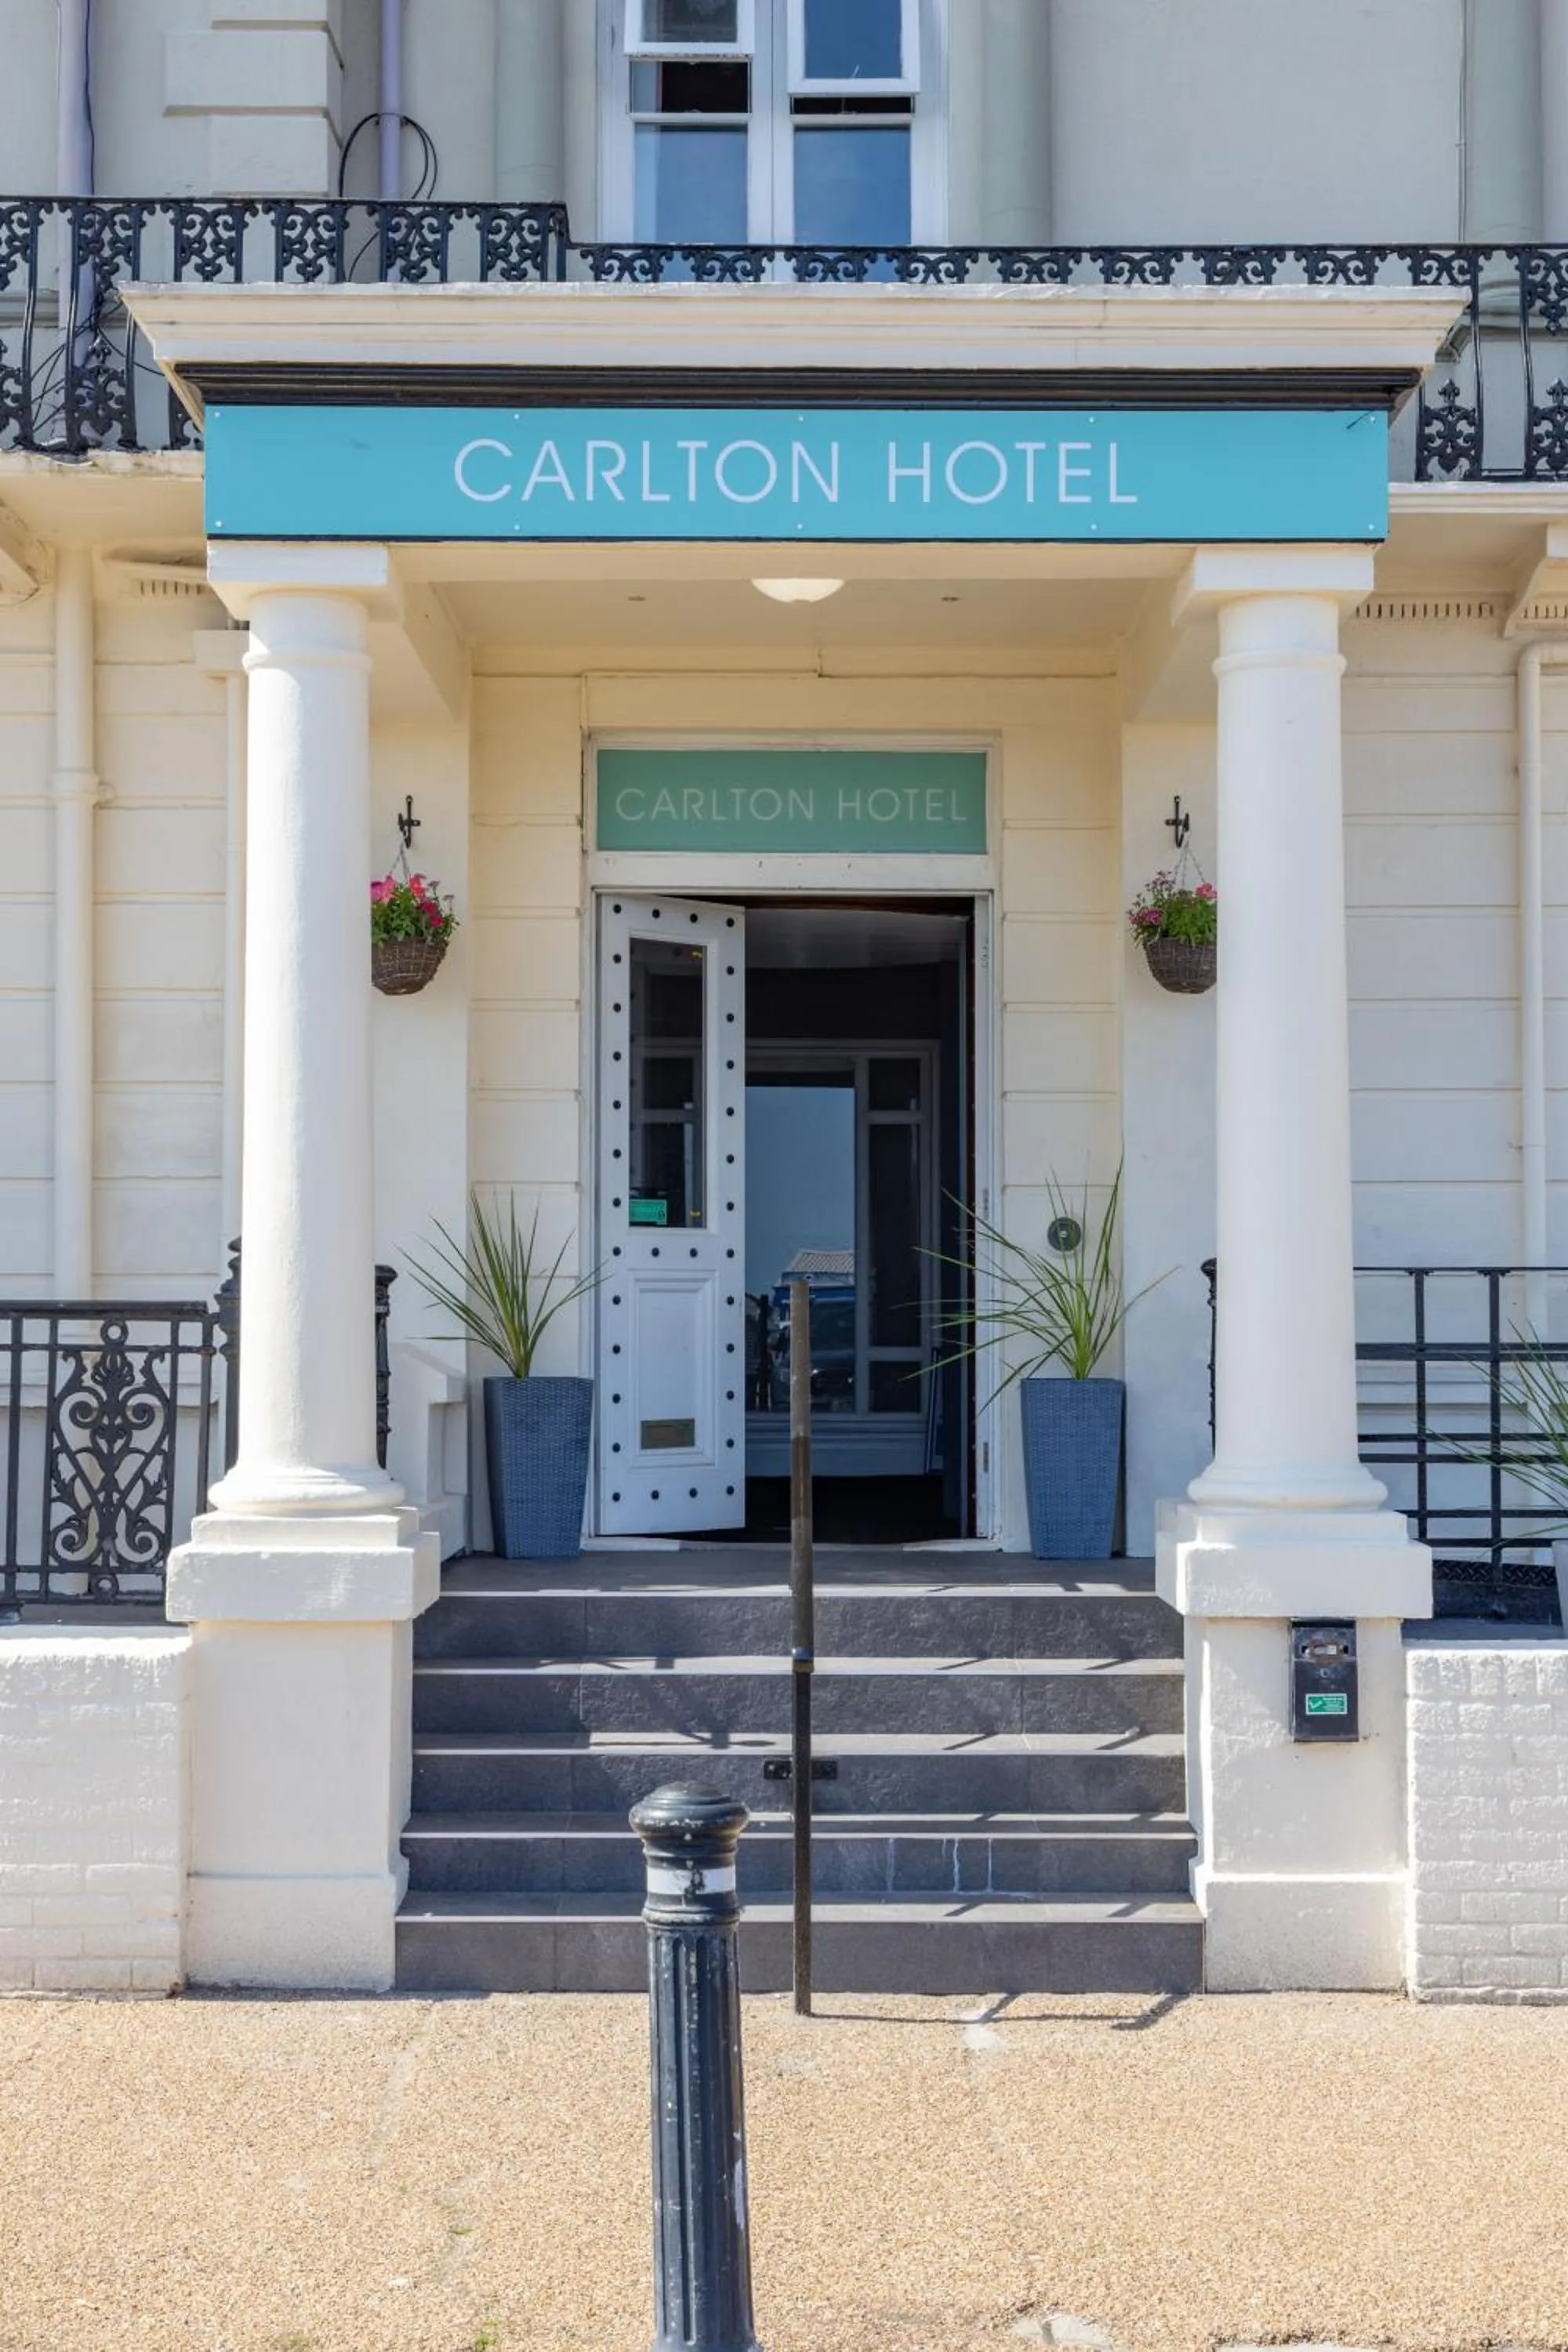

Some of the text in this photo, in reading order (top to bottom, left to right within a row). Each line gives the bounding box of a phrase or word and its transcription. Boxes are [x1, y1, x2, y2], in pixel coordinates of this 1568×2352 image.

[454, 439, 1138, 503] CARLTON HOTEL
[615, 787, 967, 822] CARLTON HOTEL
